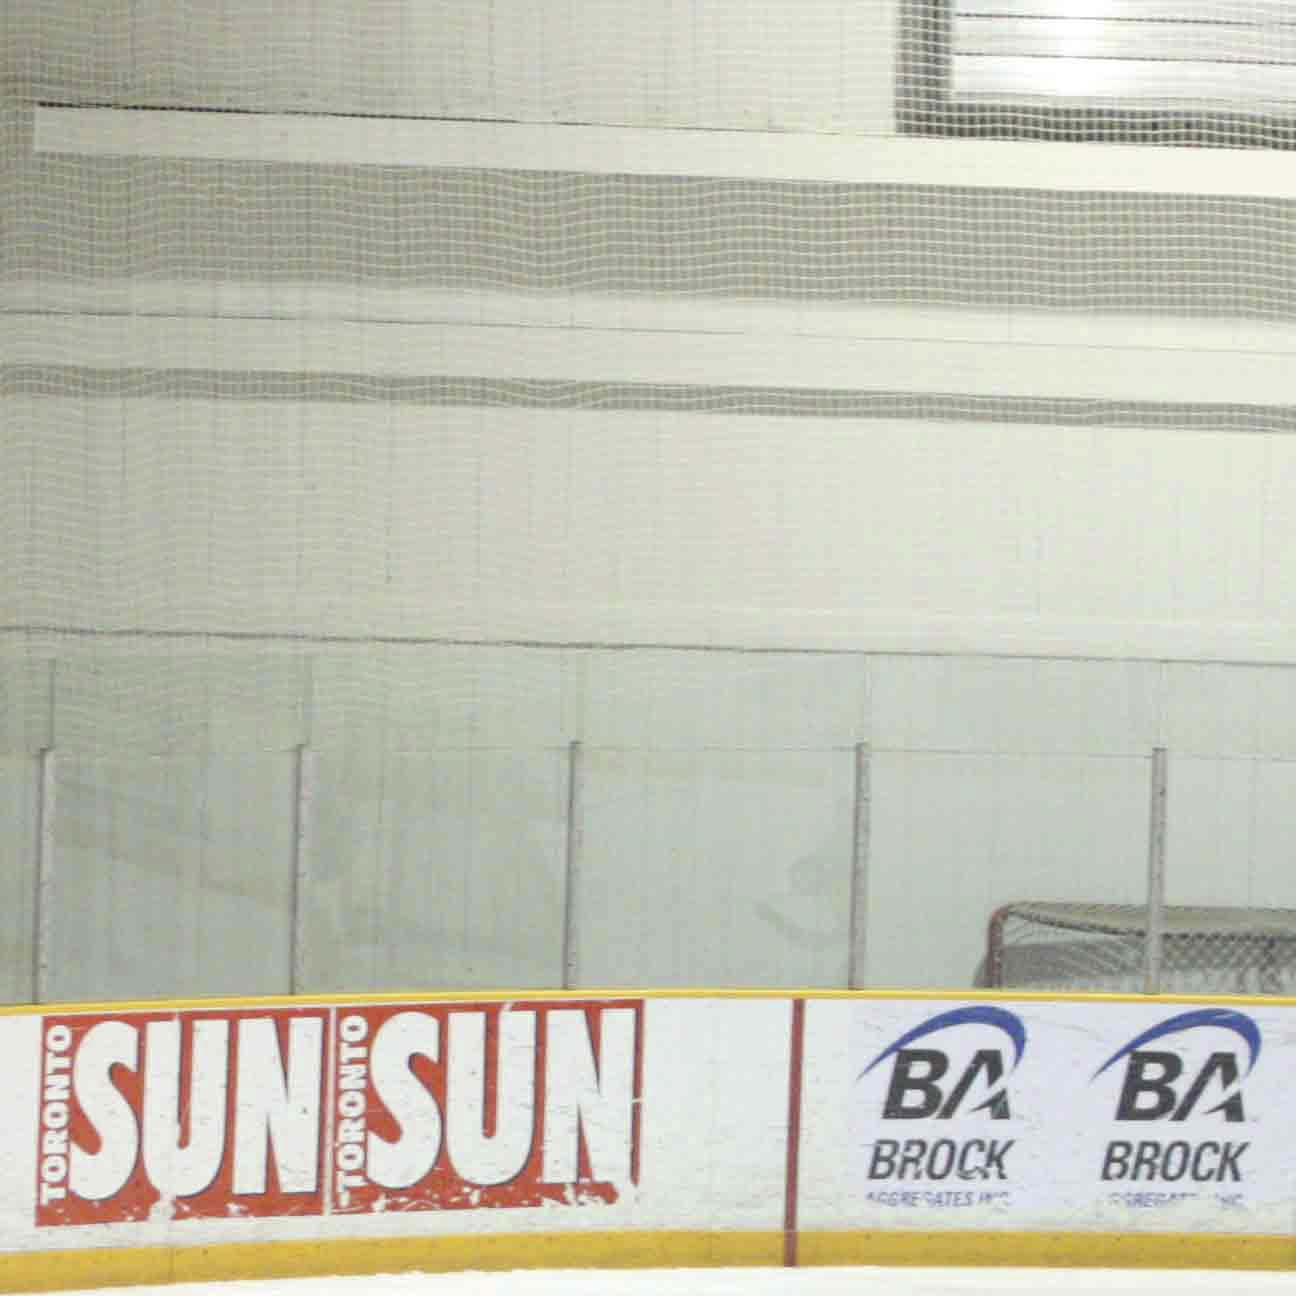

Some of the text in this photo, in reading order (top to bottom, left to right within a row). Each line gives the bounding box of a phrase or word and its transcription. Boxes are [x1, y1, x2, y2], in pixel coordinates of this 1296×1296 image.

[40, 1024, 72, 1206] TORONTO
[69, 1015, 325, 1201] SUN
[336, 1014, 369, 1192] TORONTO
[367, 1010, 637, 1190] SUN
[881, 1048, 1011, 1121] BA
[1114, 1050, 1246, 1122] BA
[867, 1138, 1016, 1181] BROCK
[1100, 1140, 1250, 1182] BROCK
